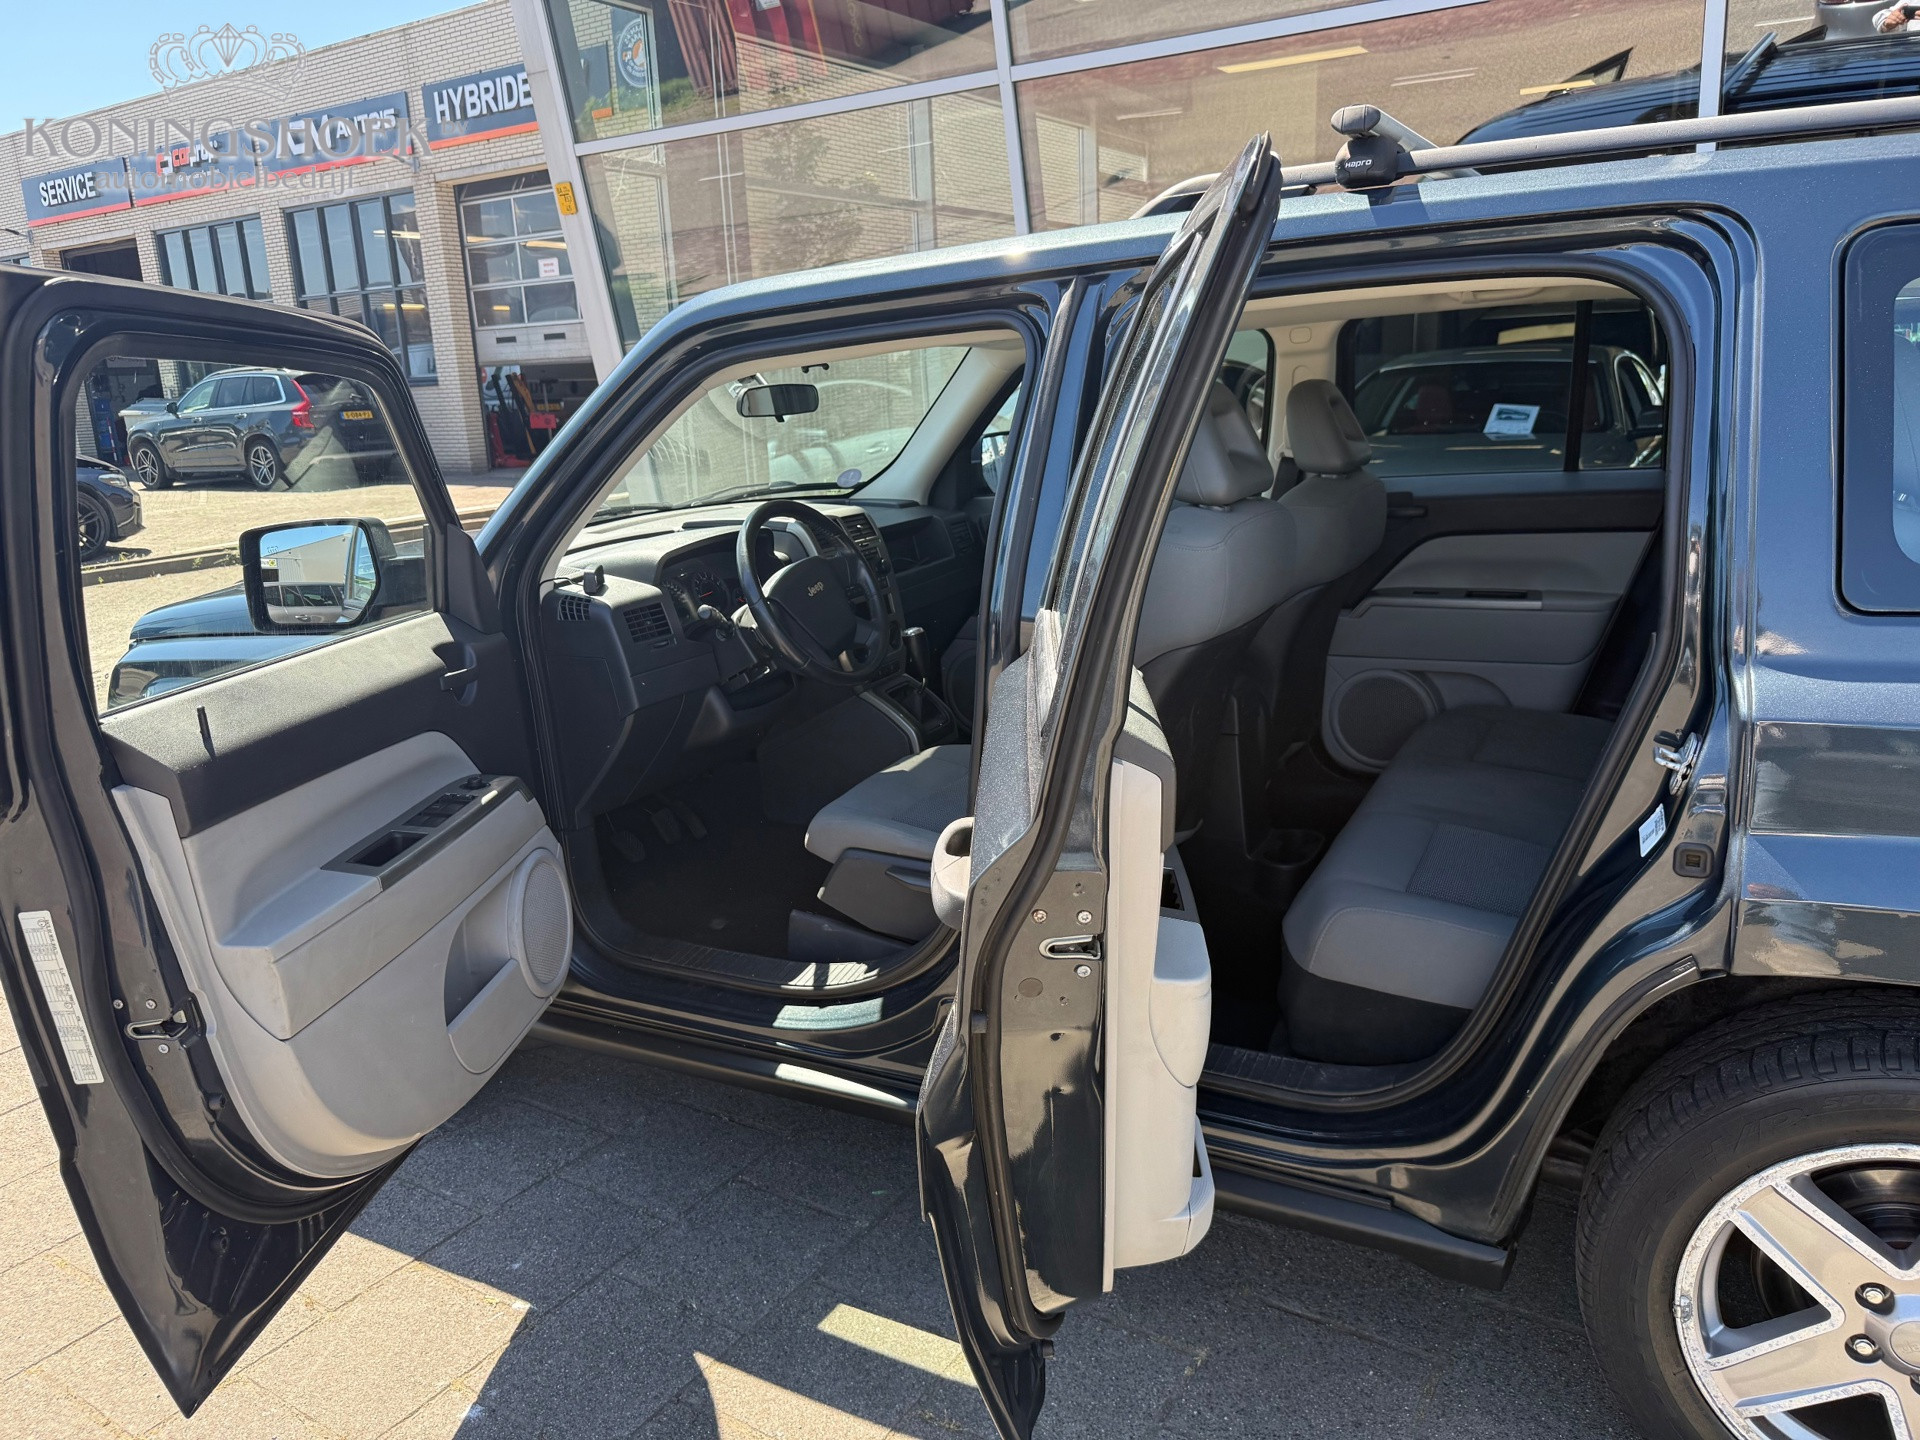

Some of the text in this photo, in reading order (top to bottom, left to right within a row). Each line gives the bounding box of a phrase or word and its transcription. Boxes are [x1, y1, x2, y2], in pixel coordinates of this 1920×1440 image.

[433, 71, 534, 124] HYBRIDE
[38, 171, 96, 207] SERVICE
[808, 581, 823, 596] Jeep
